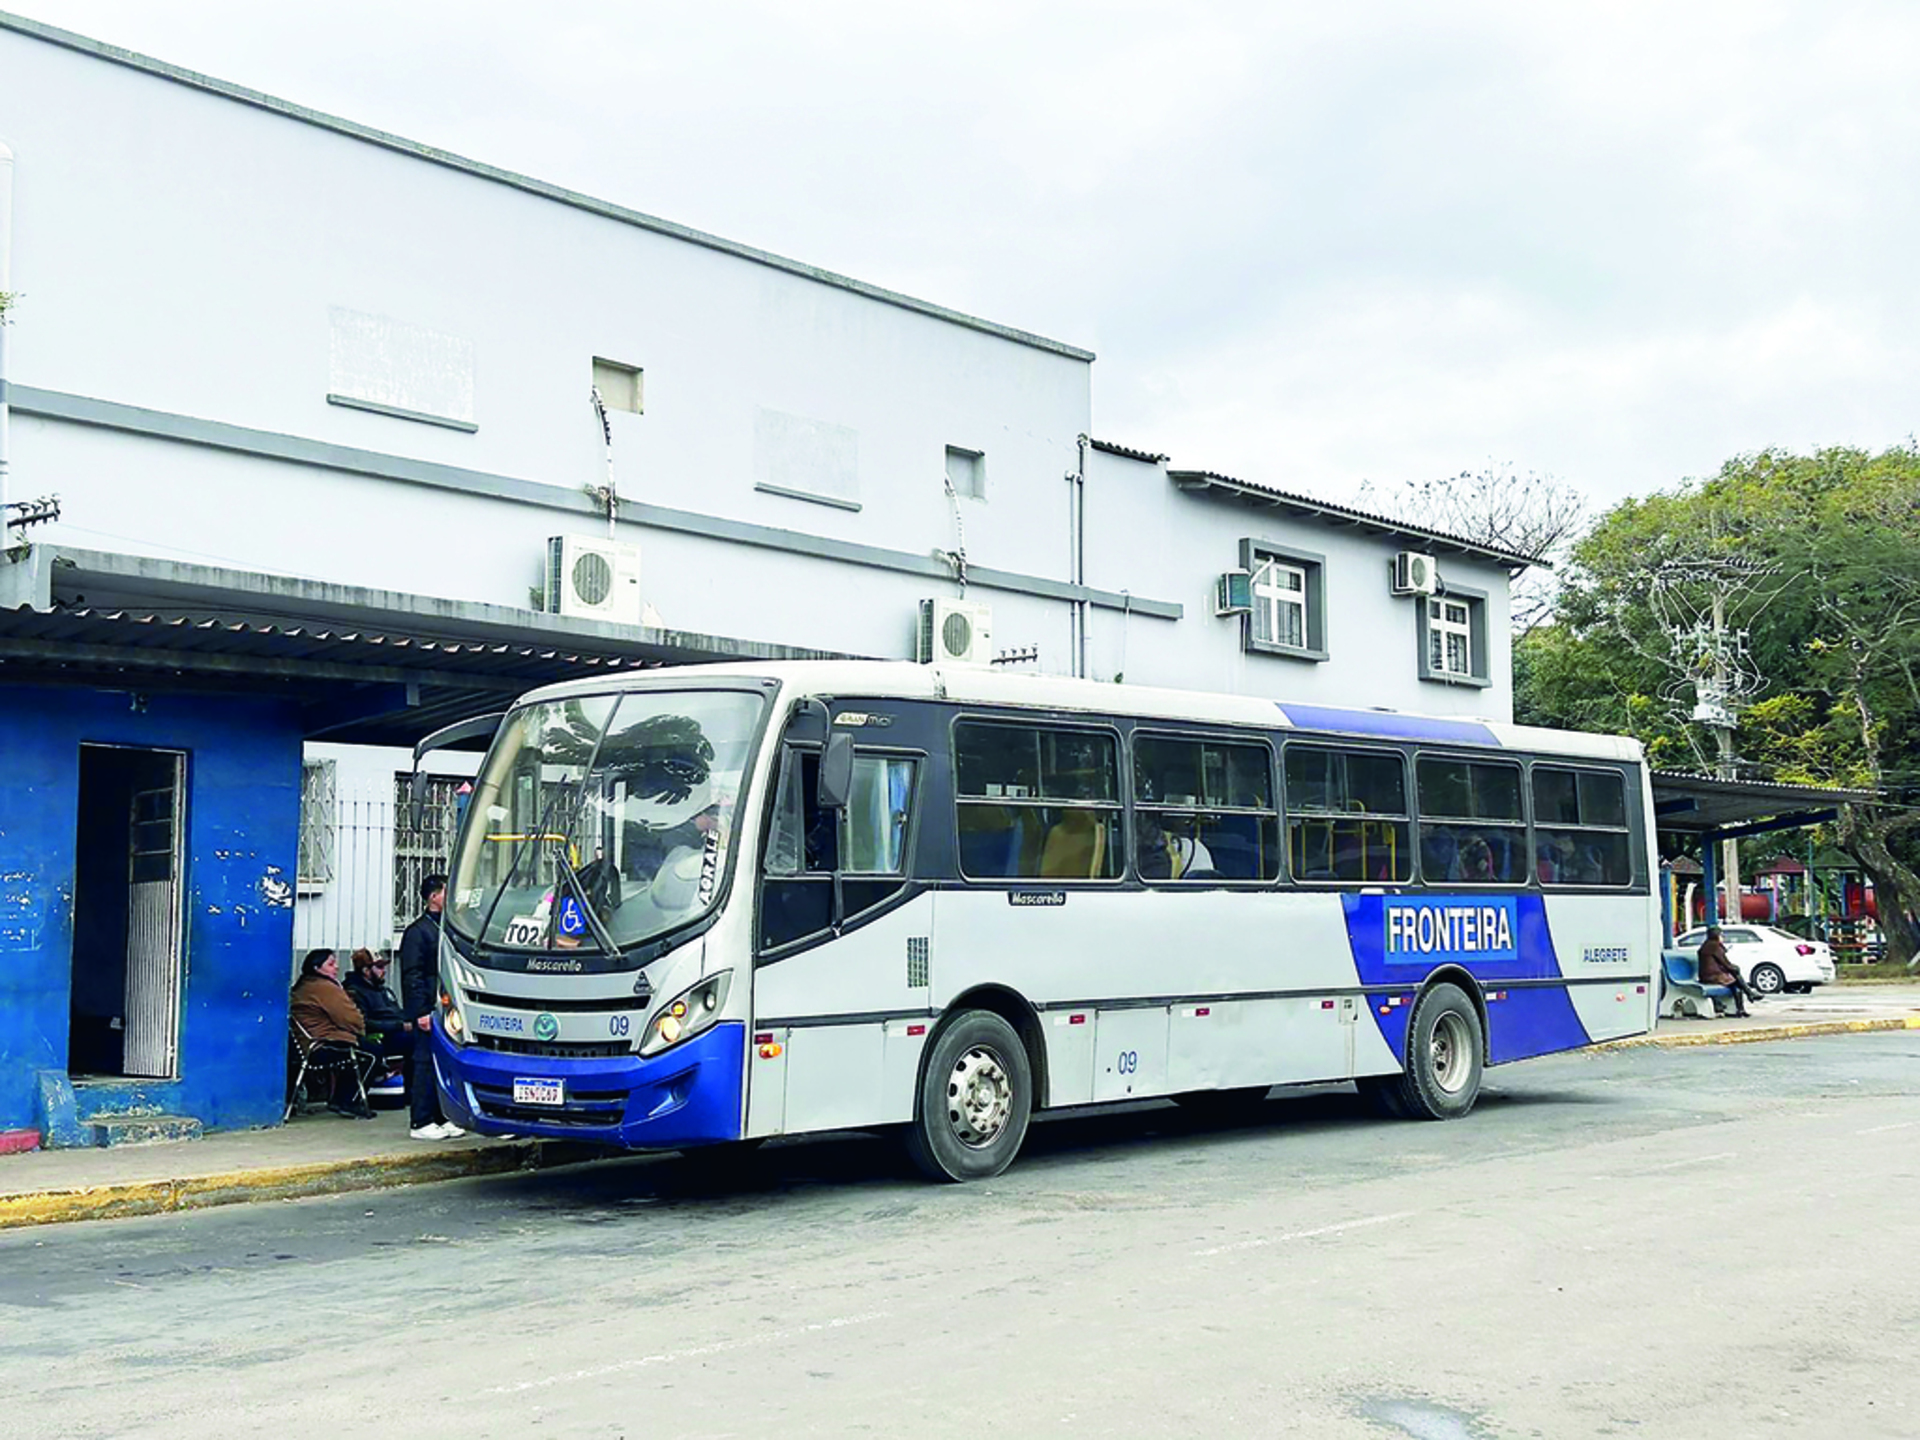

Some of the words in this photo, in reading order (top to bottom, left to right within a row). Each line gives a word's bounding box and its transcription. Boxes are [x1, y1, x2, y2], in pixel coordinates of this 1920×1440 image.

[1387, 906, 1515, 954] FRONTEIRA
[526, 957, 582, 972] Mascarello
[1582, 948, 1627, 963] ALEGRETE
[478, 1013, 525, 1032] FRONTEIRA
[610, 1015, 630, 1036] 09
[1117, 1050, 1138, 1075] 09
